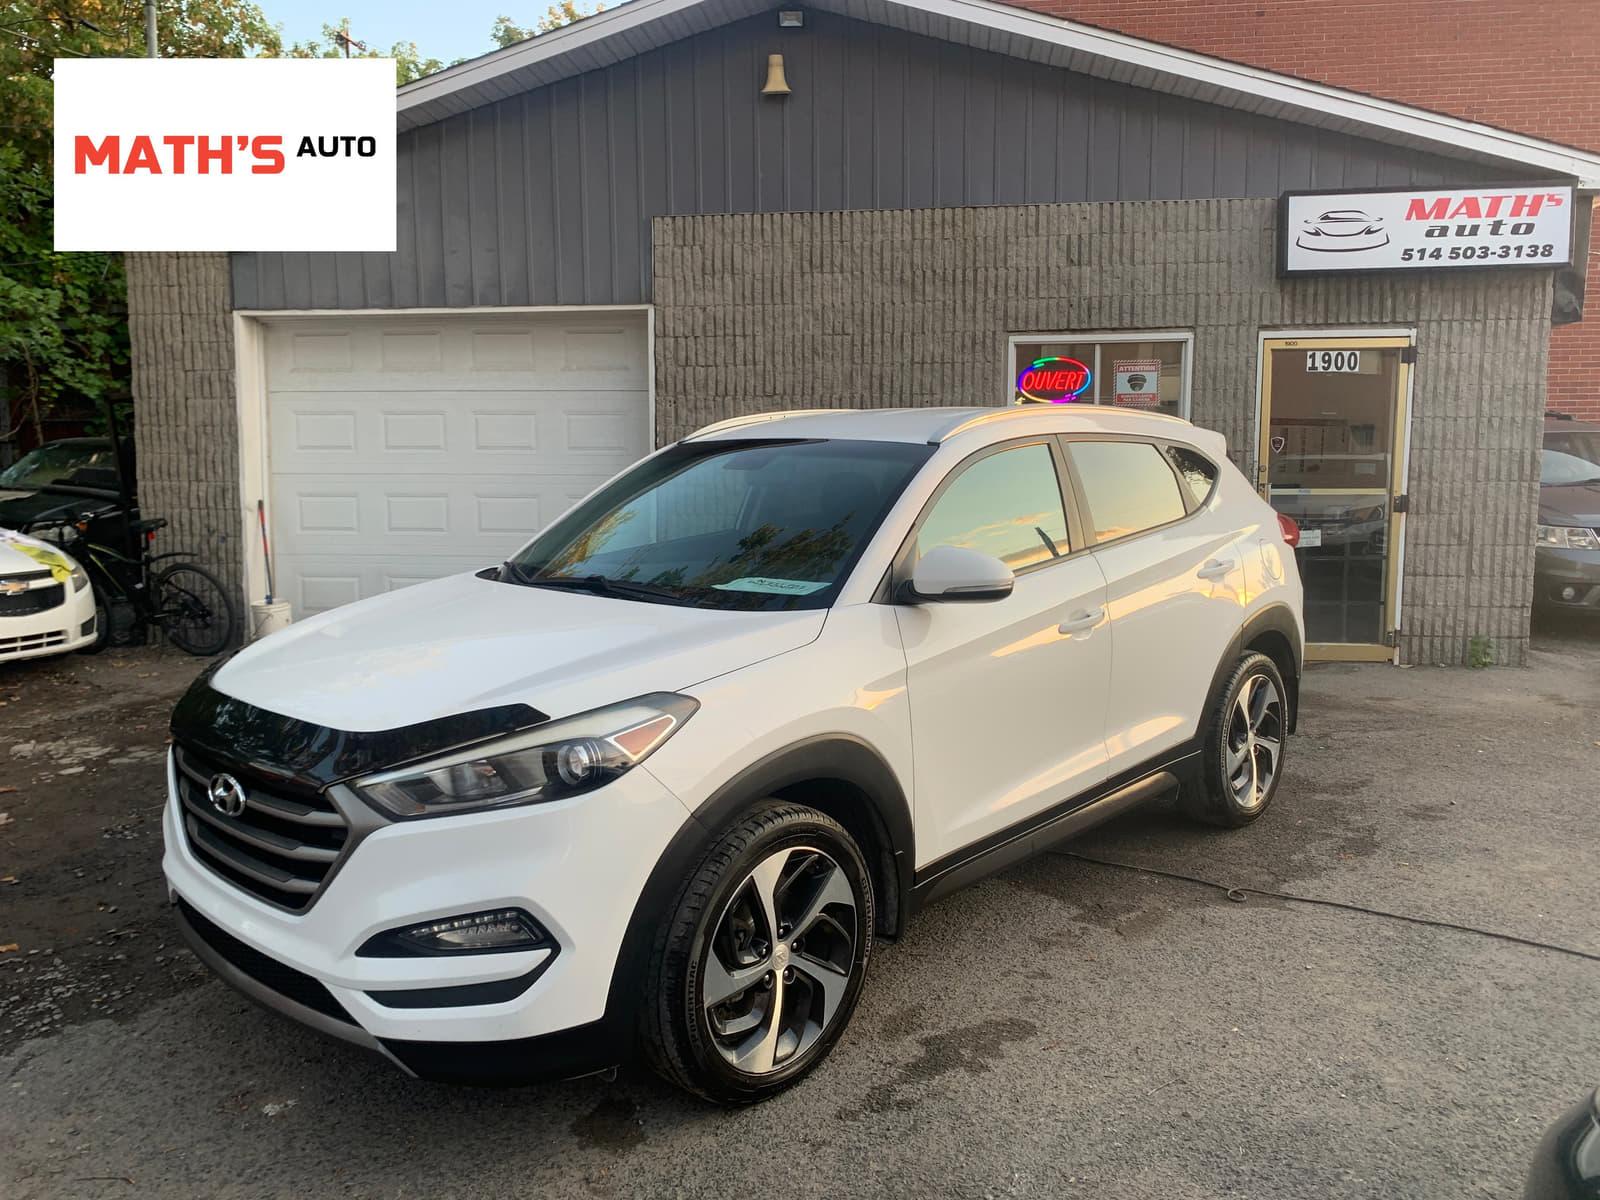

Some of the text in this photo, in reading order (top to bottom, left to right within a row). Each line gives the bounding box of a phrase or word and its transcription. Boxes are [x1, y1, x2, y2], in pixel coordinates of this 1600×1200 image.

[1424, 218, 1536, 238] auto
[1400, 244, 1555, 261] 514 503-3138
[1118, 364, 1157, 372] ATTENTION
[1307, 351, 1359, 371] 1900
[1022, 370, 1087, 391] OUVERT
